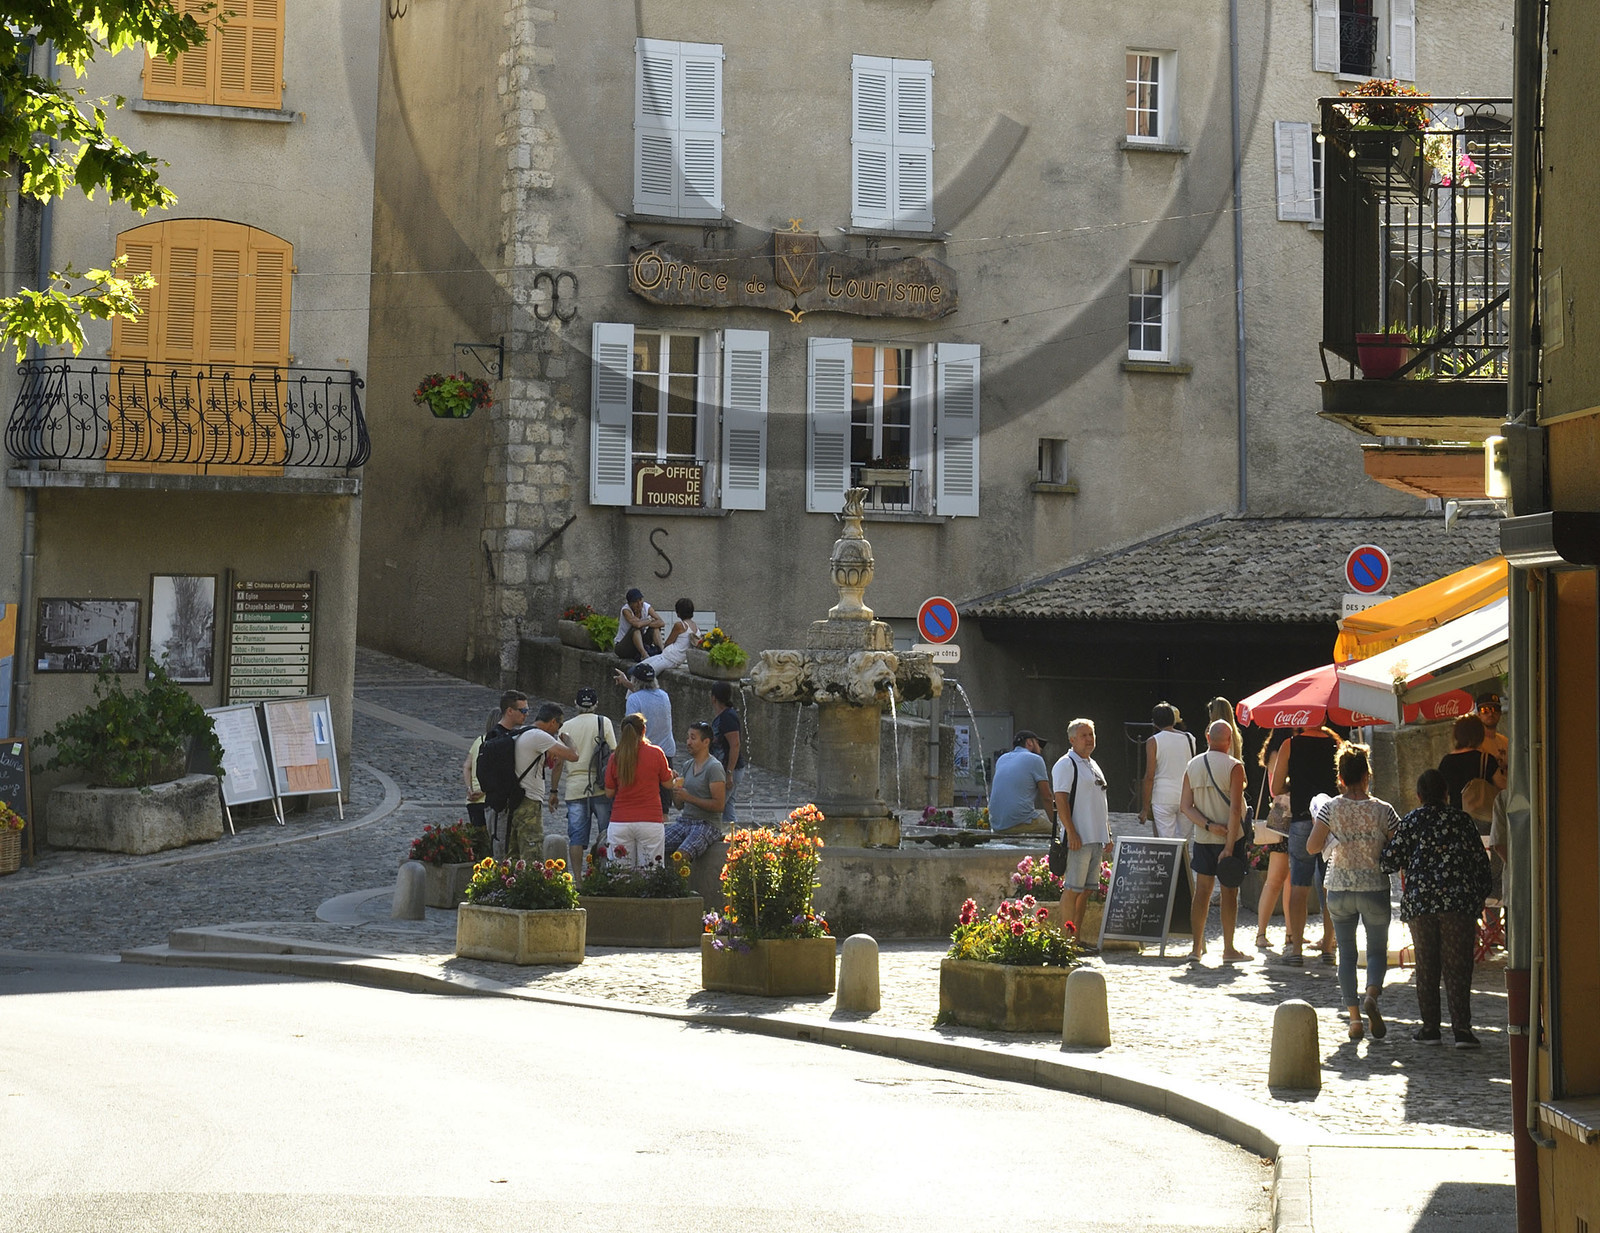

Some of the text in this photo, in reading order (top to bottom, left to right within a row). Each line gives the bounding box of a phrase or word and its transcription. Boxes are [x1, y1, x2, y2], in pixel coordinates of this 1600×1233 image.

[634, 250, 942, 304] Office de tourisme
[666, 466, 700, 479] OFFICE
[686, 480, 700, 493] DE
[647, 492, 700, 505] TOURISME
